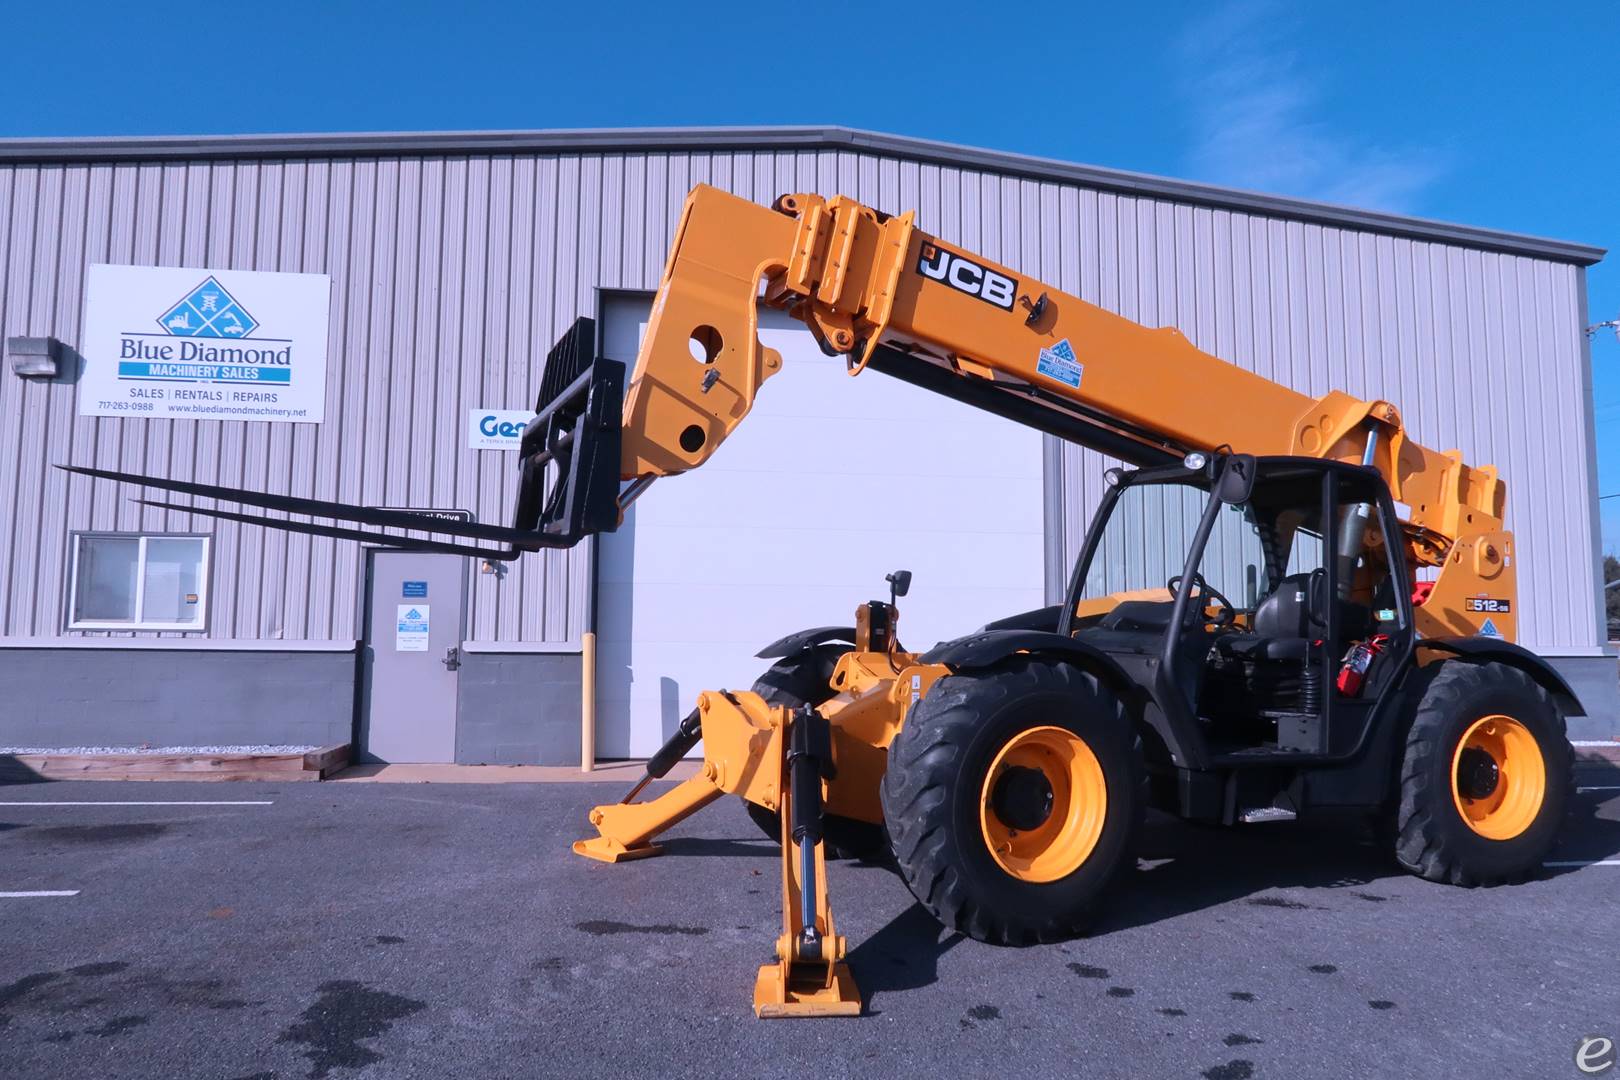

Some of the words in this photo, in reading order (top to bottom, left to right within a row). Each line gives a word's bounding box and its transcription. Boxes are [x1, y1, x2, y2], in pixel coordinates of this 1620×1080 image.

[920, 251, 1015, 308] JCB
[120, 338, 173, 361] Blue
[179, 341, 292, 366] Diamond
[149, 364, 220, 379] MACHINERY
[221, 368, 259, 380] SALES
[129, 388, 164, 399] SALES
[174, 389, 223, 401] RENTALS
[233, 391, 278, 403] REPAIRS
[98, 401, 154, 411] 717-263-0988
[168, 404, 307, 418] www.bluediamondmachinery.net
